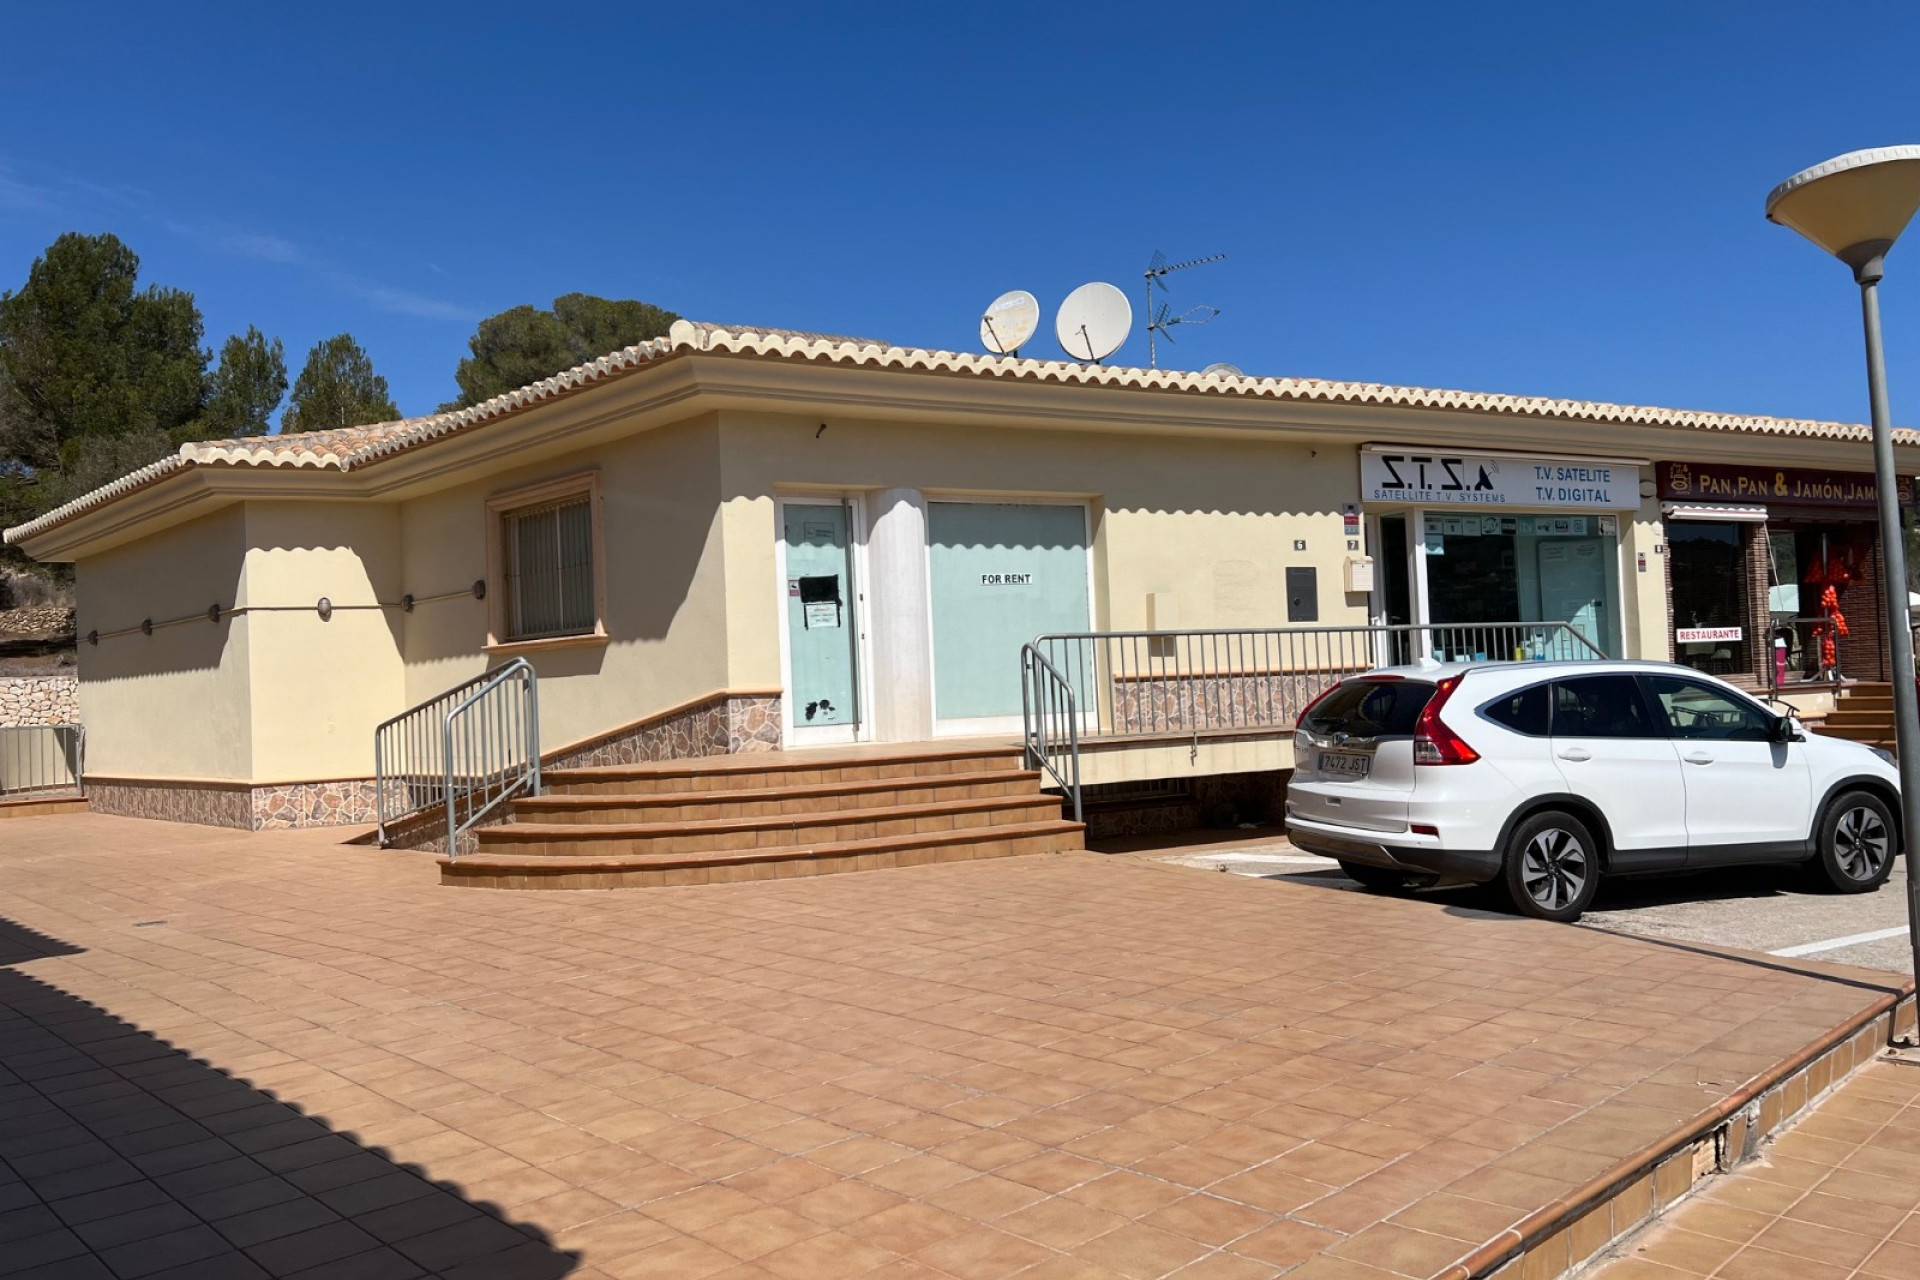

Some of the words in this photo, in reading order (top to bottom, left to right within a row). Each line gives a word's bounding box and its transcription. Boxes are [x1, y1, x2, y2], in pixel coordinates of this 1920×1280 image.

[1535, 466, 1554, 480] T.V.
[1557, 467, 1611, 482] SATELITE
[1774, 472, 1788, 497] &
[1374, 489, 1431, 500] SATELLITE
[1460, 491, 1506, 503] SYSTEMS
[1535, 486, 1555, 501] T.V.
[1558, 488, 1611, 503] DIGITAL
[1297, 541, 1303, 550] 6
[1349, 541, 1356, 550] 7
[982, 574, 1002, 584] FOR
[1005, 573, 1031, 584] RENT
[1680, 629, 1740, 640] RESTAURANTE
[1325, 755, 1346, 770] 7472
